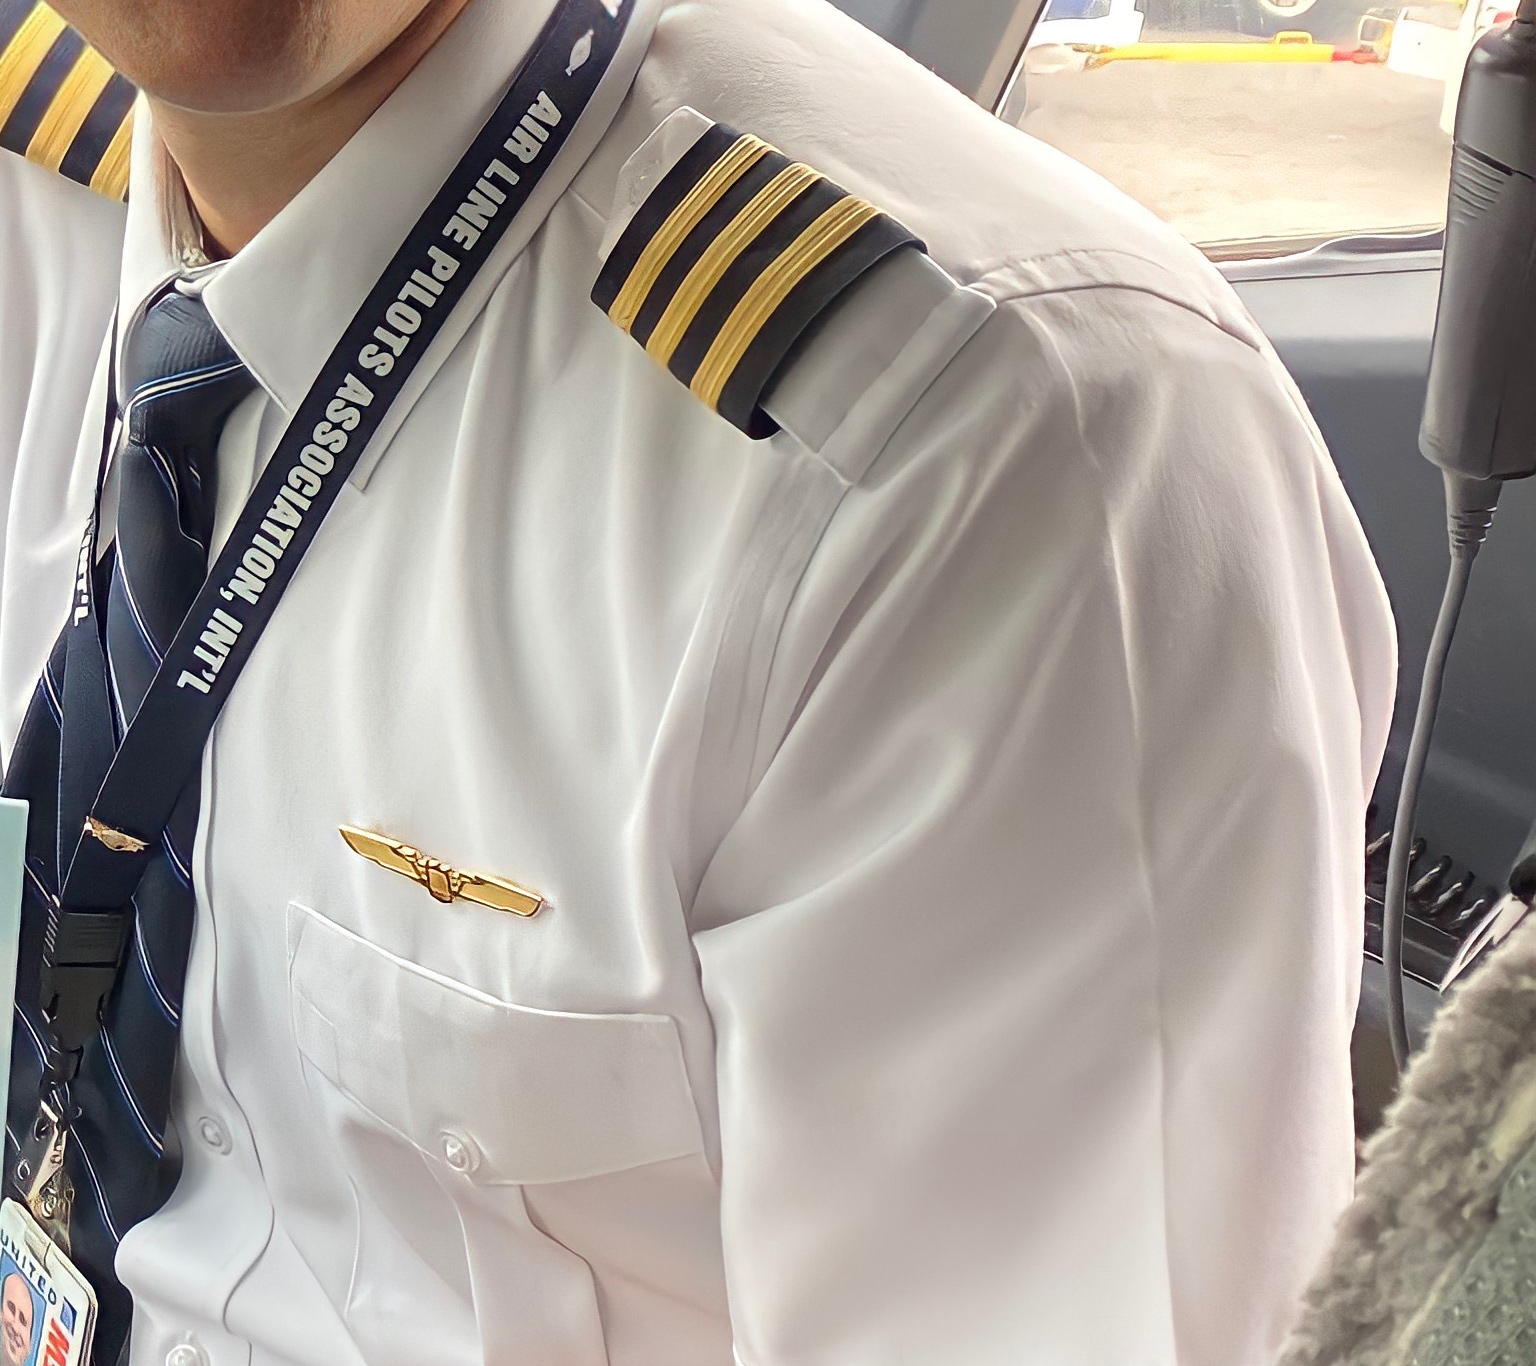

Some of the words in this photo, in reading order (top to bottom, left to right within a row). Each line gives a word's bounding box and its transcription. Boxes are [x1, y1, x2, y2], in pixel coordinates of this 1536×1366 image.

[503, 90, 562, 164] AIR
[441, 158, 521, 251] LINE
[357, 245, 461, 377] PILOTS
[219, 372, 374, 605] ASSOCIATION,
[176, 607, 244, 695] INT'L
